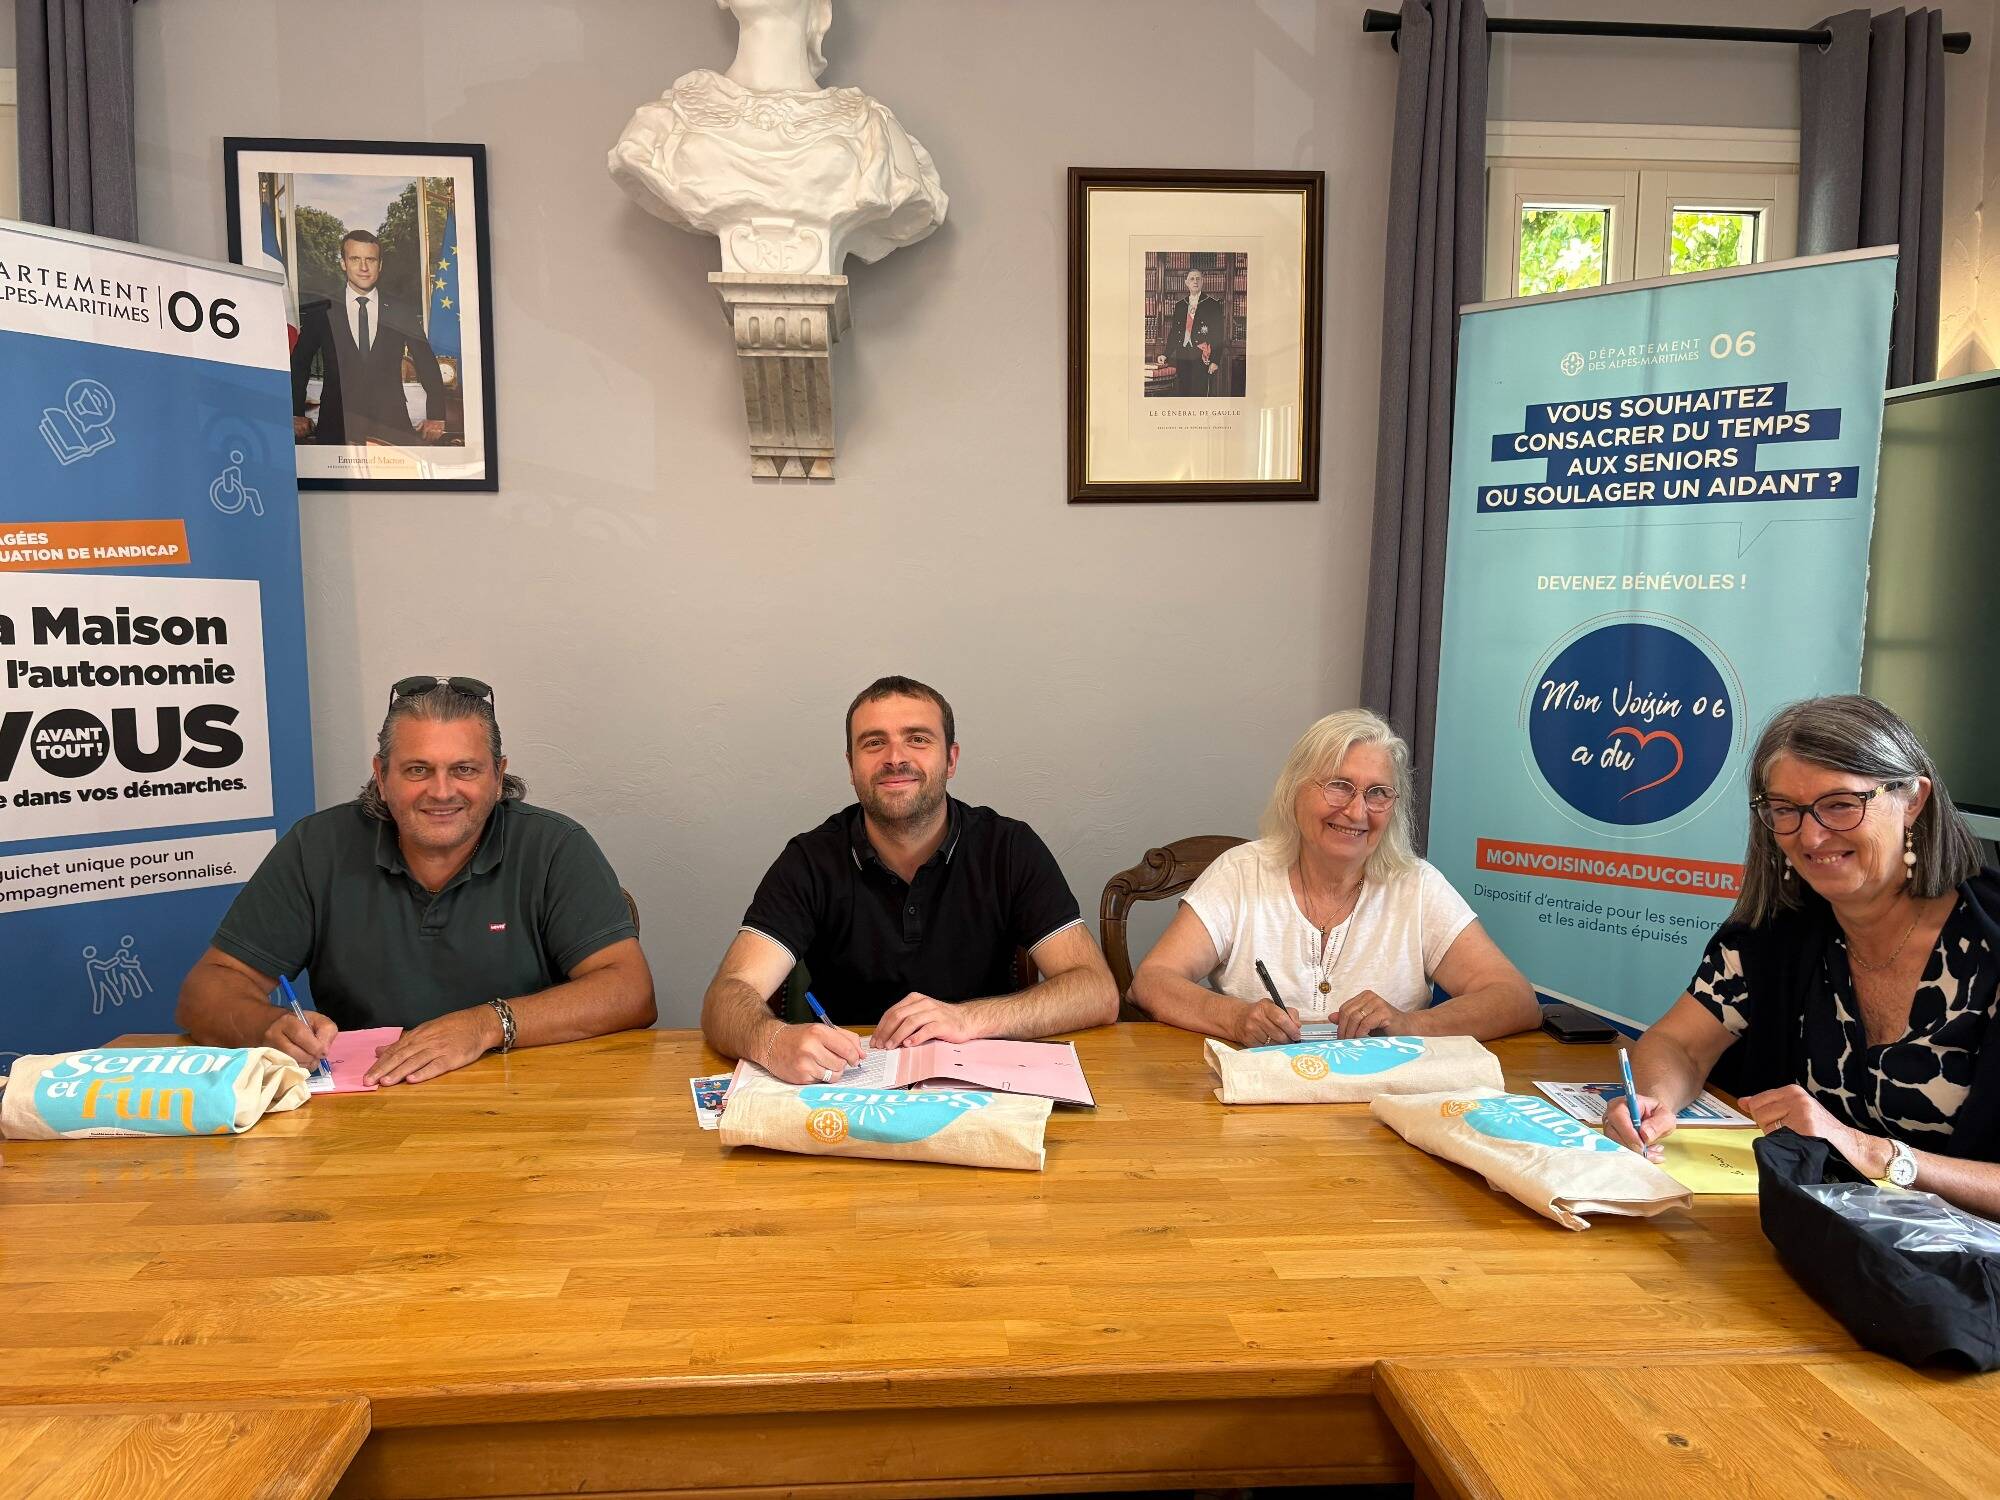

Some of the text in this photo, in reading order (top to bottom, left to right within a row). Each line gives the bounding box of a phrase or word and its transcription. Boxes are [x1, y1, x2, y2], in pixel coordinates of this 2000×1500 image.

[168, 290, 240, 339] 06
[1588, 338, 1701, 361] DÉPARTEMENT
[1710, 330, 1756, 359] 06
[1588, 351, 1700, 372] DES ALPES-MARITIMES
[1546, 386, 1775, 424] VOUS SOUHAITEZ
[1514, 413, 1811, 453] CONSACRER DU TEMPS
[1566, 447, 1739, 477] AUX SENIORS
[1485, 471, 1843, 507] OU SOULAGER UN AIDANT ?
[67, 547, 90, 559] DE
[94, 544, 179, 559] HANDICAP
[1537, 572, 1746, 590] DEVENEZ BÉNÉVOLES !
[32, 606, 228, 646] Maison
[1541, 680, 1602, 713] Mon
[1612, 681, 1682, 723] Voisin
[35, 727, 103, 743] AVANT
[1571, 738, 1635, 771] a du
[13, 789, 72, 807] dans
[76, 786, 119, 802] vos
[123, 776, 248, 799] démarches.
[65, 857, 125, 873] unique
[130, 853, 170, 868] pour
[174, 849, 194, 862] un
[130, 862, 237, 889] personnalisé.
[1474, 883, 1532, 904] Dispositif
[1606, 906, 1642, 920] pour
[1645, 908, 1666, 924] les
[1538, 912, 1688, 945] et les aidants épuisés
[41, 1049, 240, 1079] Senior
[47, 1079, 83, 1098] et
[818, 1092, 995, 1110] Senior
[81, 1075, 197, 1133] Fun
